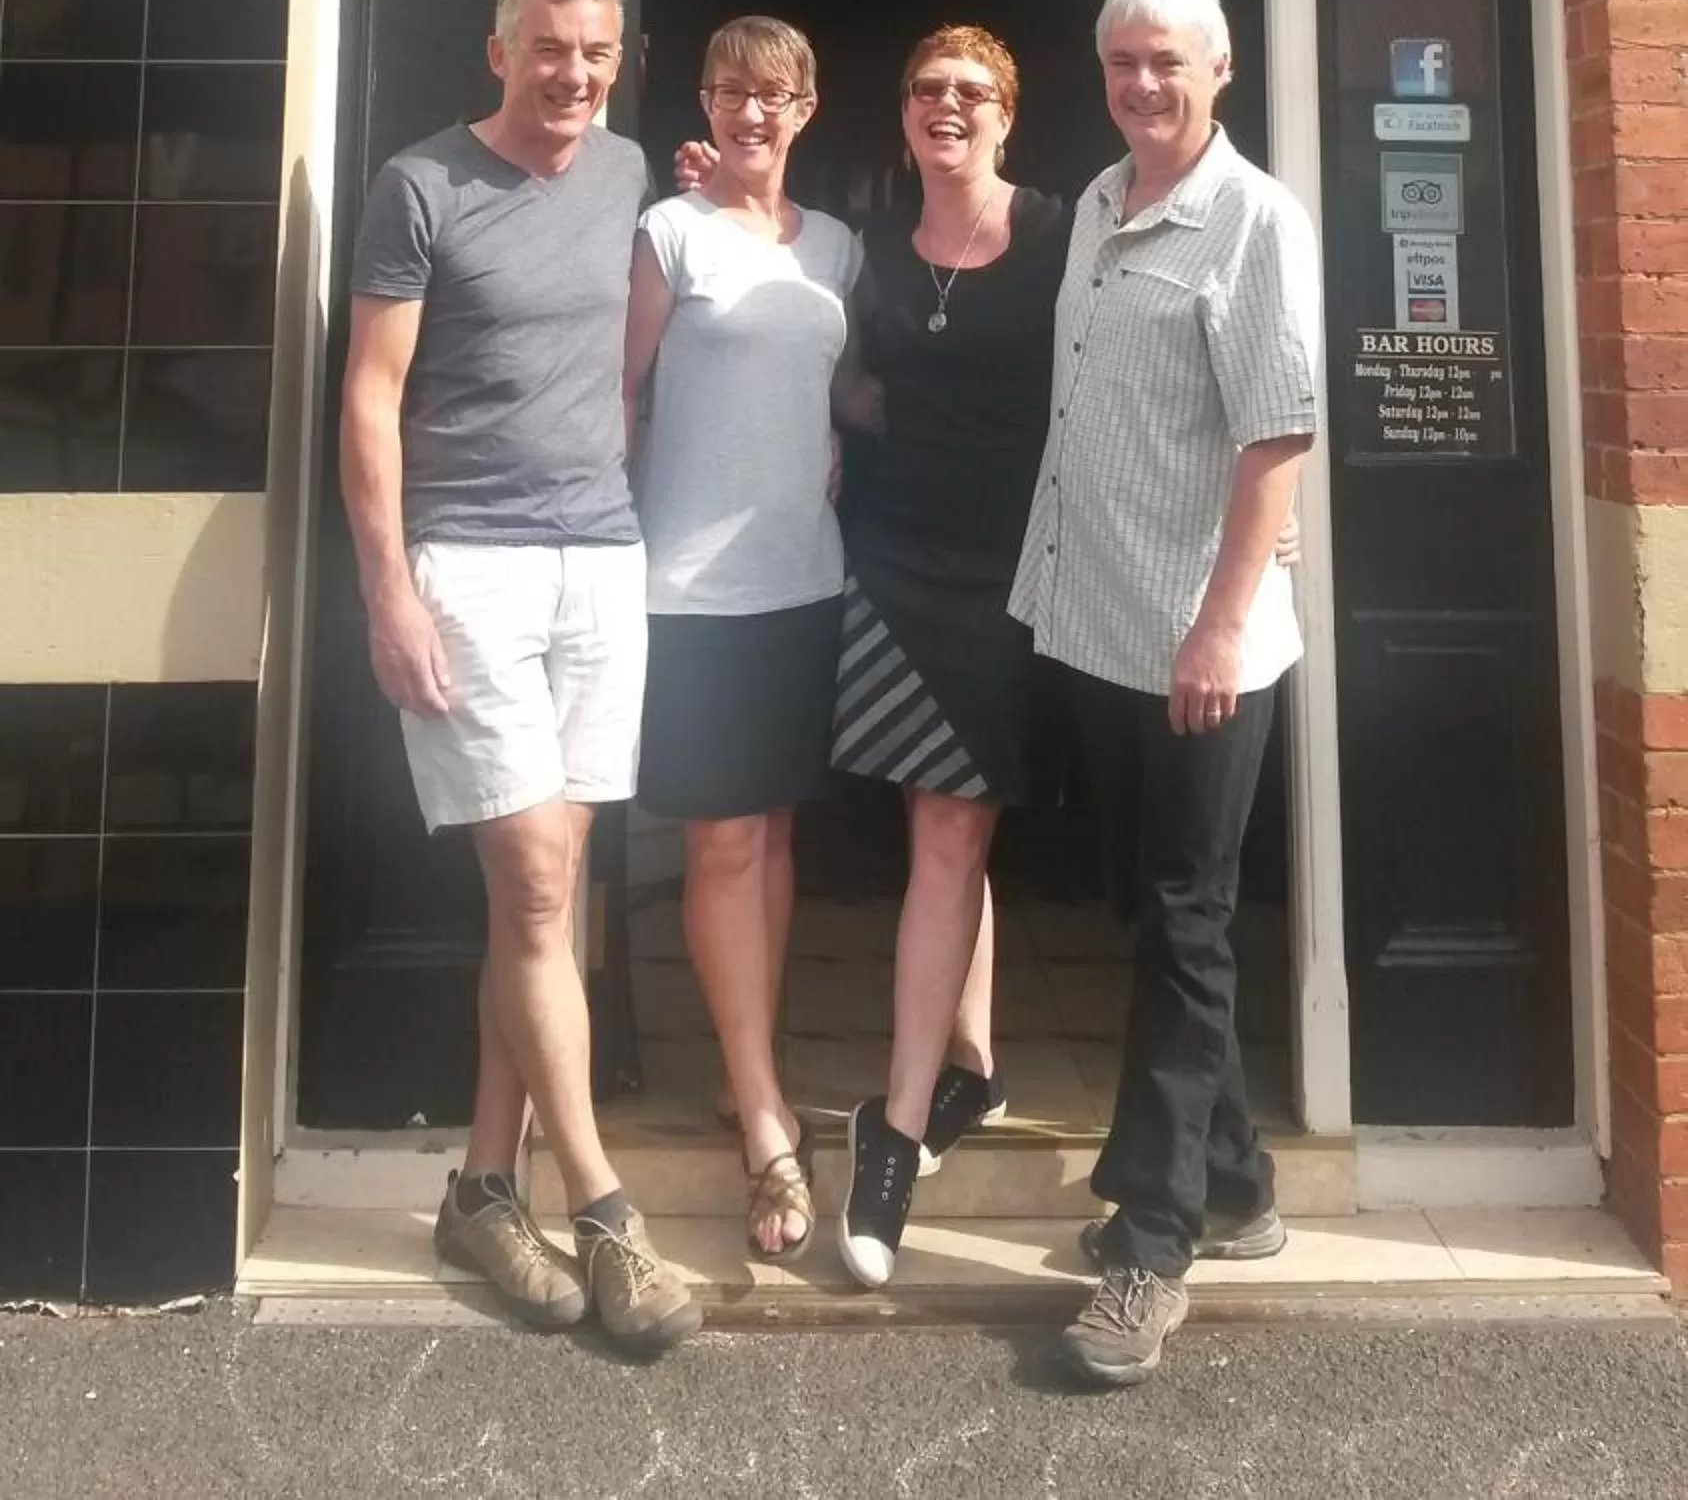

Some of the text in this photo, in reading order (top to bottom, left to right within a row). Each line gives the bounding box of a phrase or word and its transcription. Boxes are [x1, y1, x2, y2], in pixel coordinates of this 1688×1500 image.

[1413, 273, 1445, 287] VISA
[1362, 335, 1495, 355] BAR HOURS
[1384, 384, 1417, 401] Friday
[1378, 404, 1423, 422] Saturday
[1383, 426, 1419, 443] Sunday
